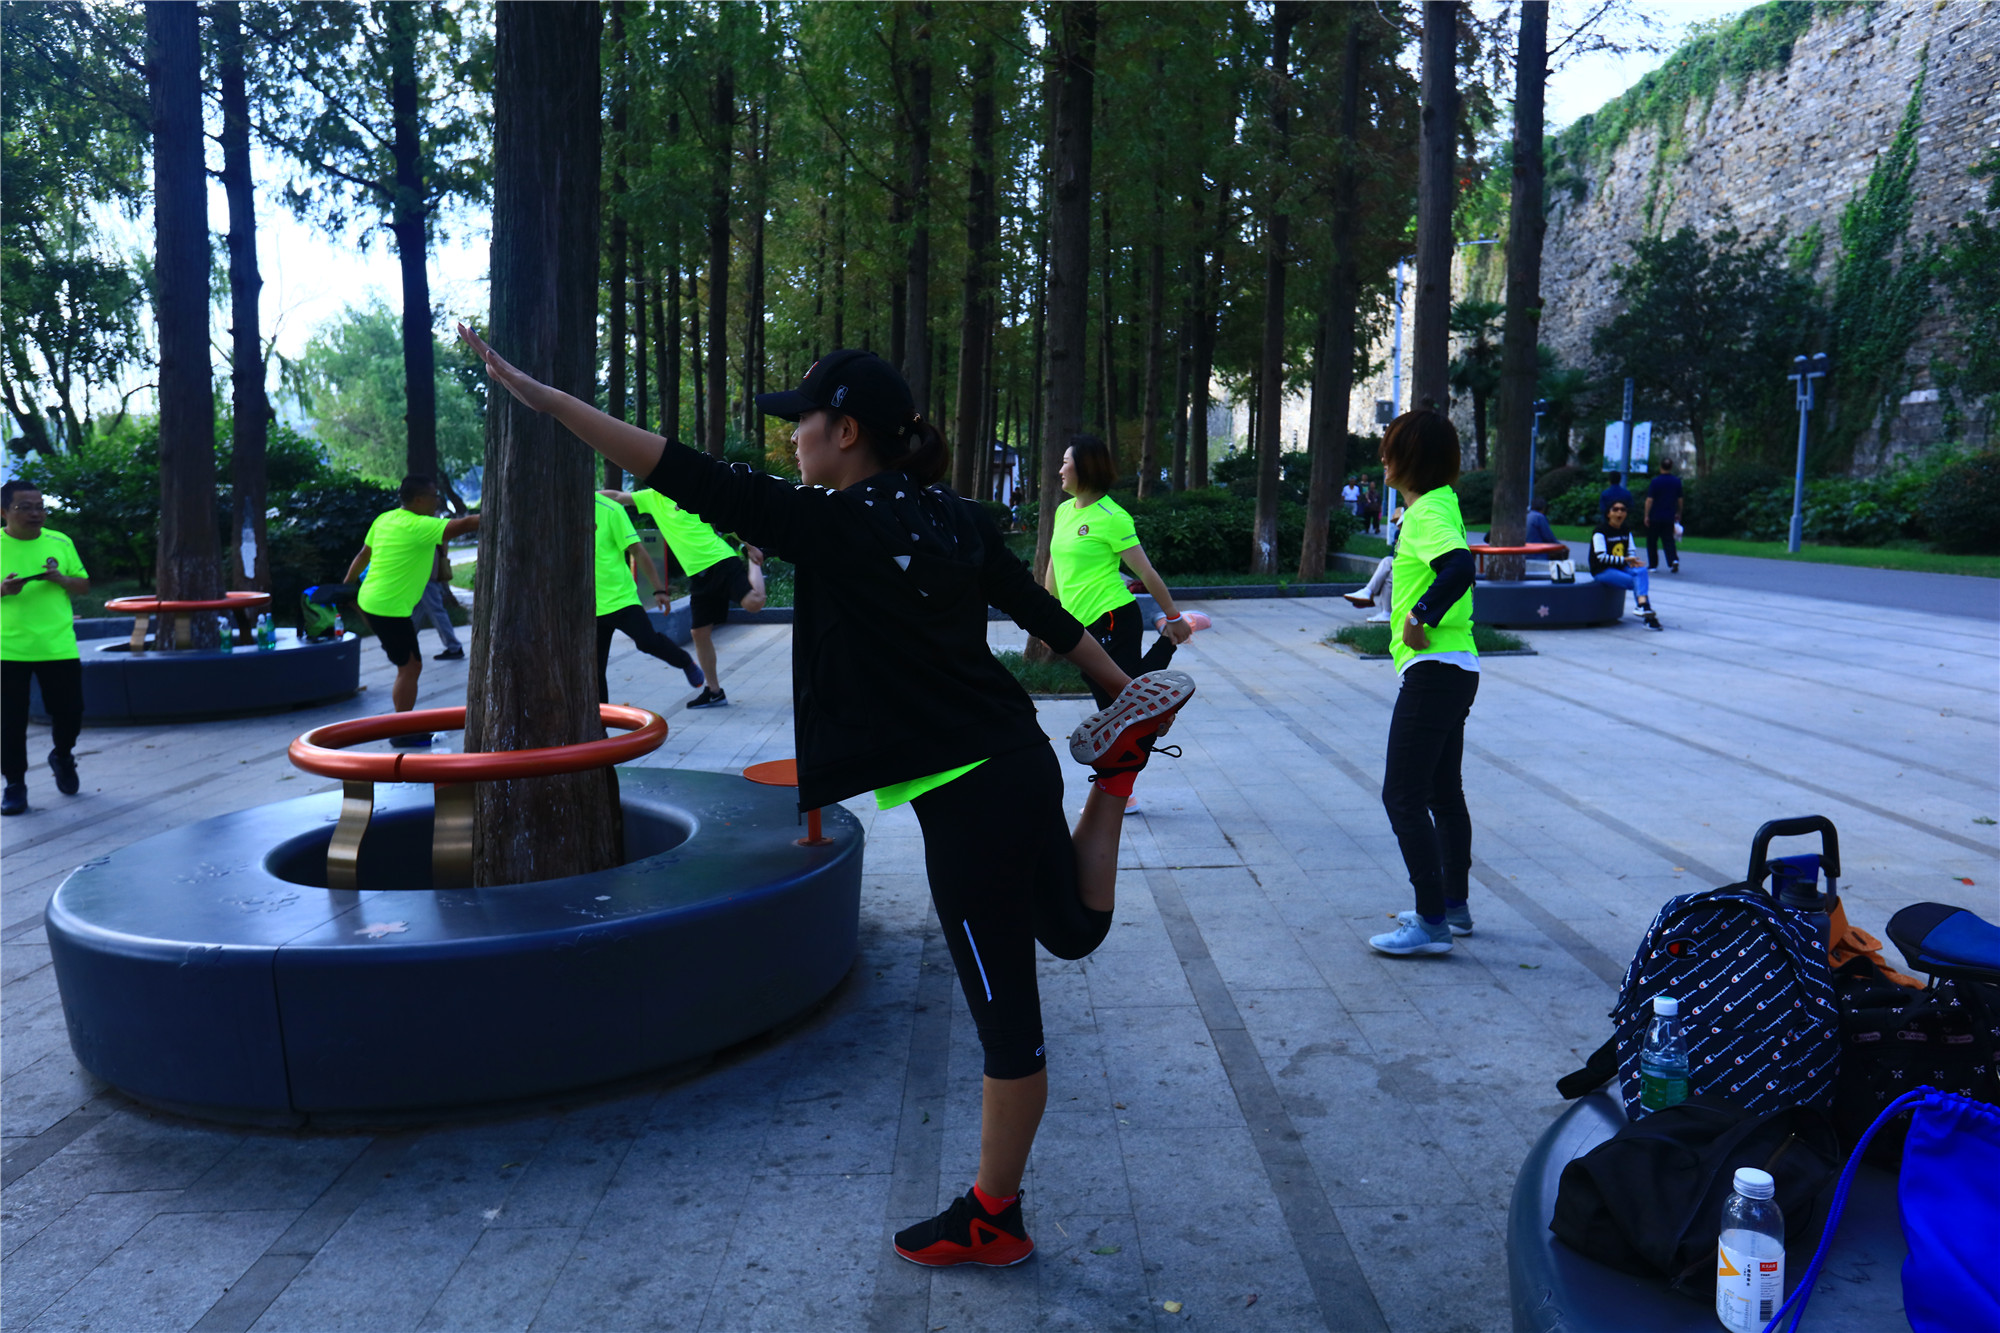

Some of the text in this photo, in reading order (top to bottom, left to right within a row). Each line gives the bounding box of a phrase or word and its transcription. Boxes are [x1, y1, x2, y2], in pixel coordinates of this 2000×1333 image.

[1669, 958, 1709, 986] Champion
[1699, 959, 1737, 989] Champion
[1731, 953, 1770, 984] Champion
[1692, 986, 1729, 1015] Champion
[1723, 982, 1763, 1012] Champion
[1756, 980, 1795, 1011] Champion
[1704, 1036, 1744, 1064] Champion
[1734, 1035, 1775, 1065] Champion
[1730, 1063, 1771, 1093] Champion
